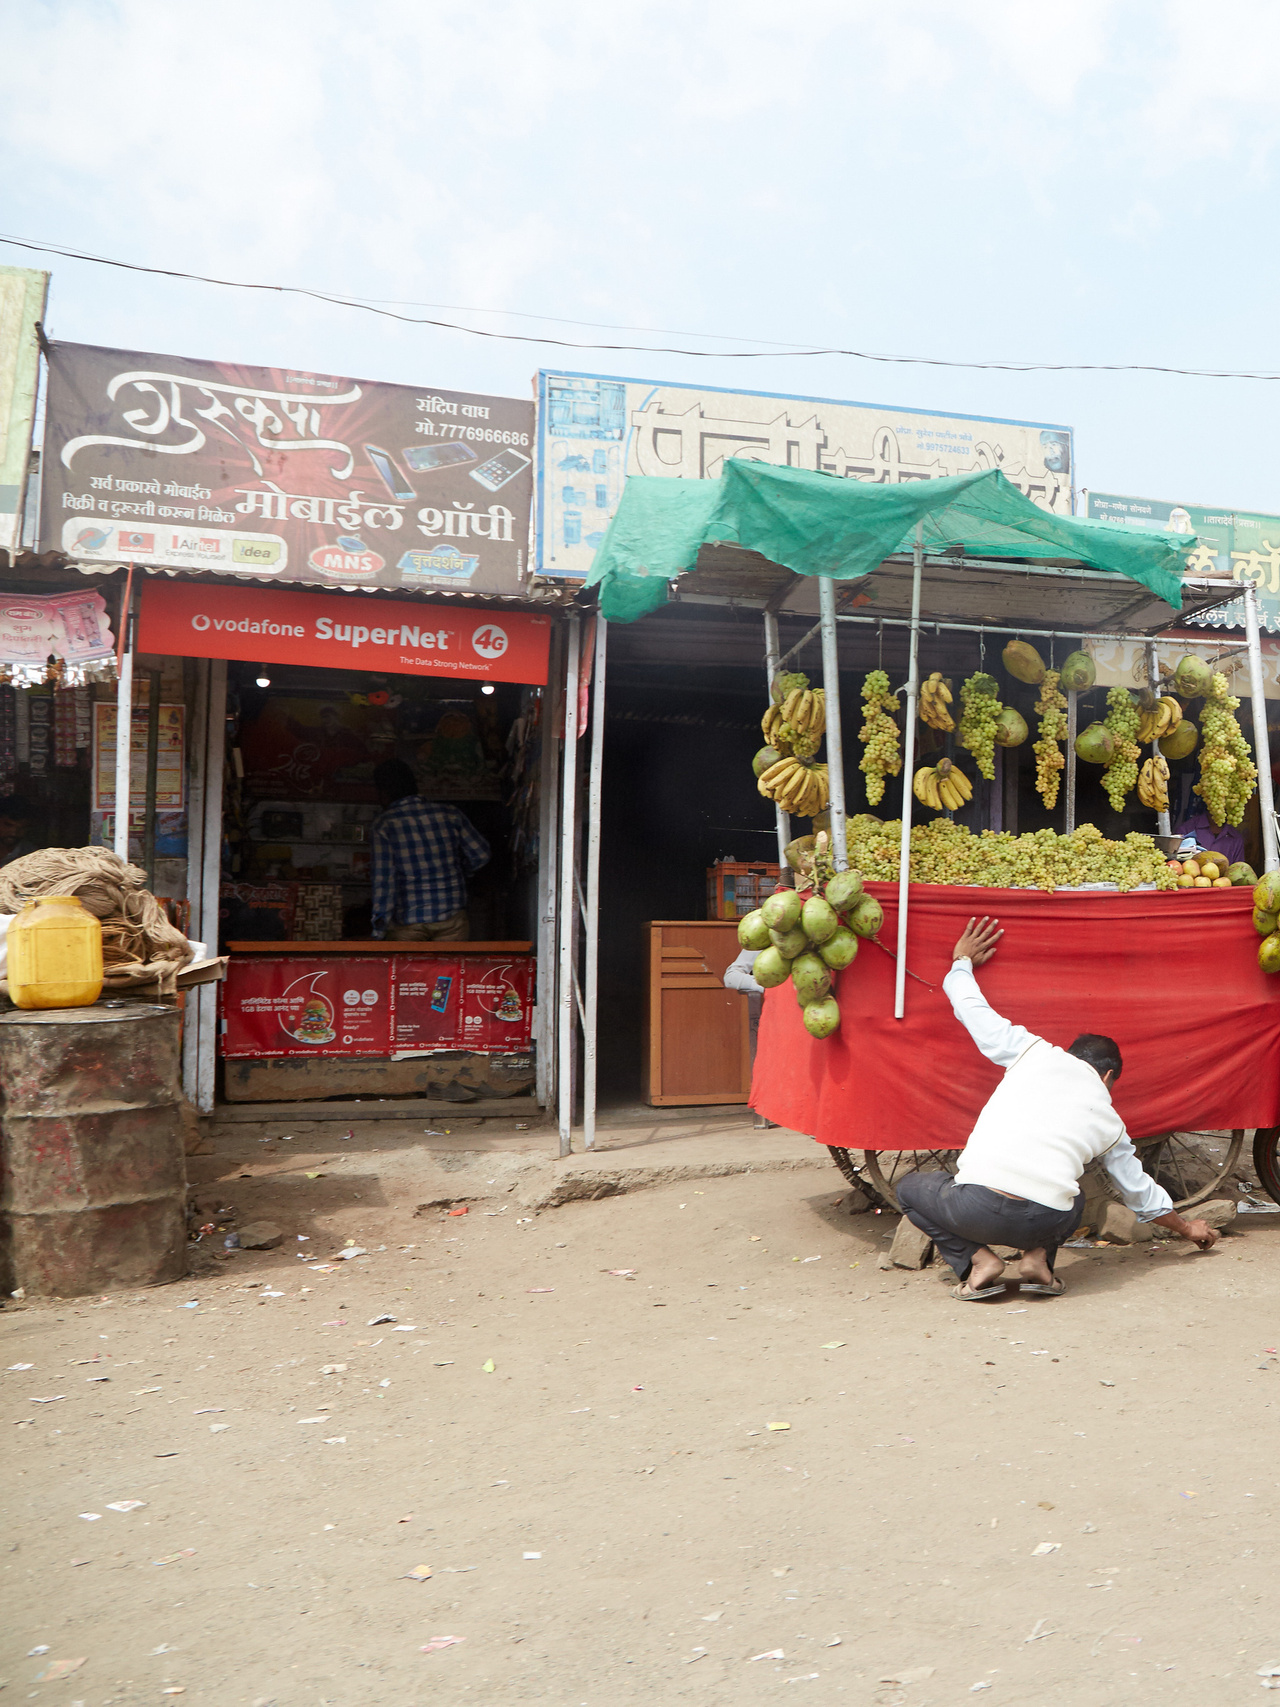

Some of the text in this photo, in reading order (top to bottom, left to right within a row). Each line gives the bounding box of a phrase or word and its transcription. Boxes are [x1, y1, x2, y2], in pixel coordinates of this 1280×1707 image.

[462, 403, 490, 420] वाघ
[90, 474, 212, 500] सर्व प्रकारचे मोबाईल
[98, 500, 109, 511] व
[198, 506, 236, 524] मिळेल
[234, 480, 516, 542] मोबाईल शॉपी
[323, 554, 372, 571] MNS
[213, 617, 305, 638] vodafone
[474, 627, 505, 652] 4G
[400, 656, 415, 666] The
[415, 658, 433, 668] Data
[434, 660, 458, 671] Strong
